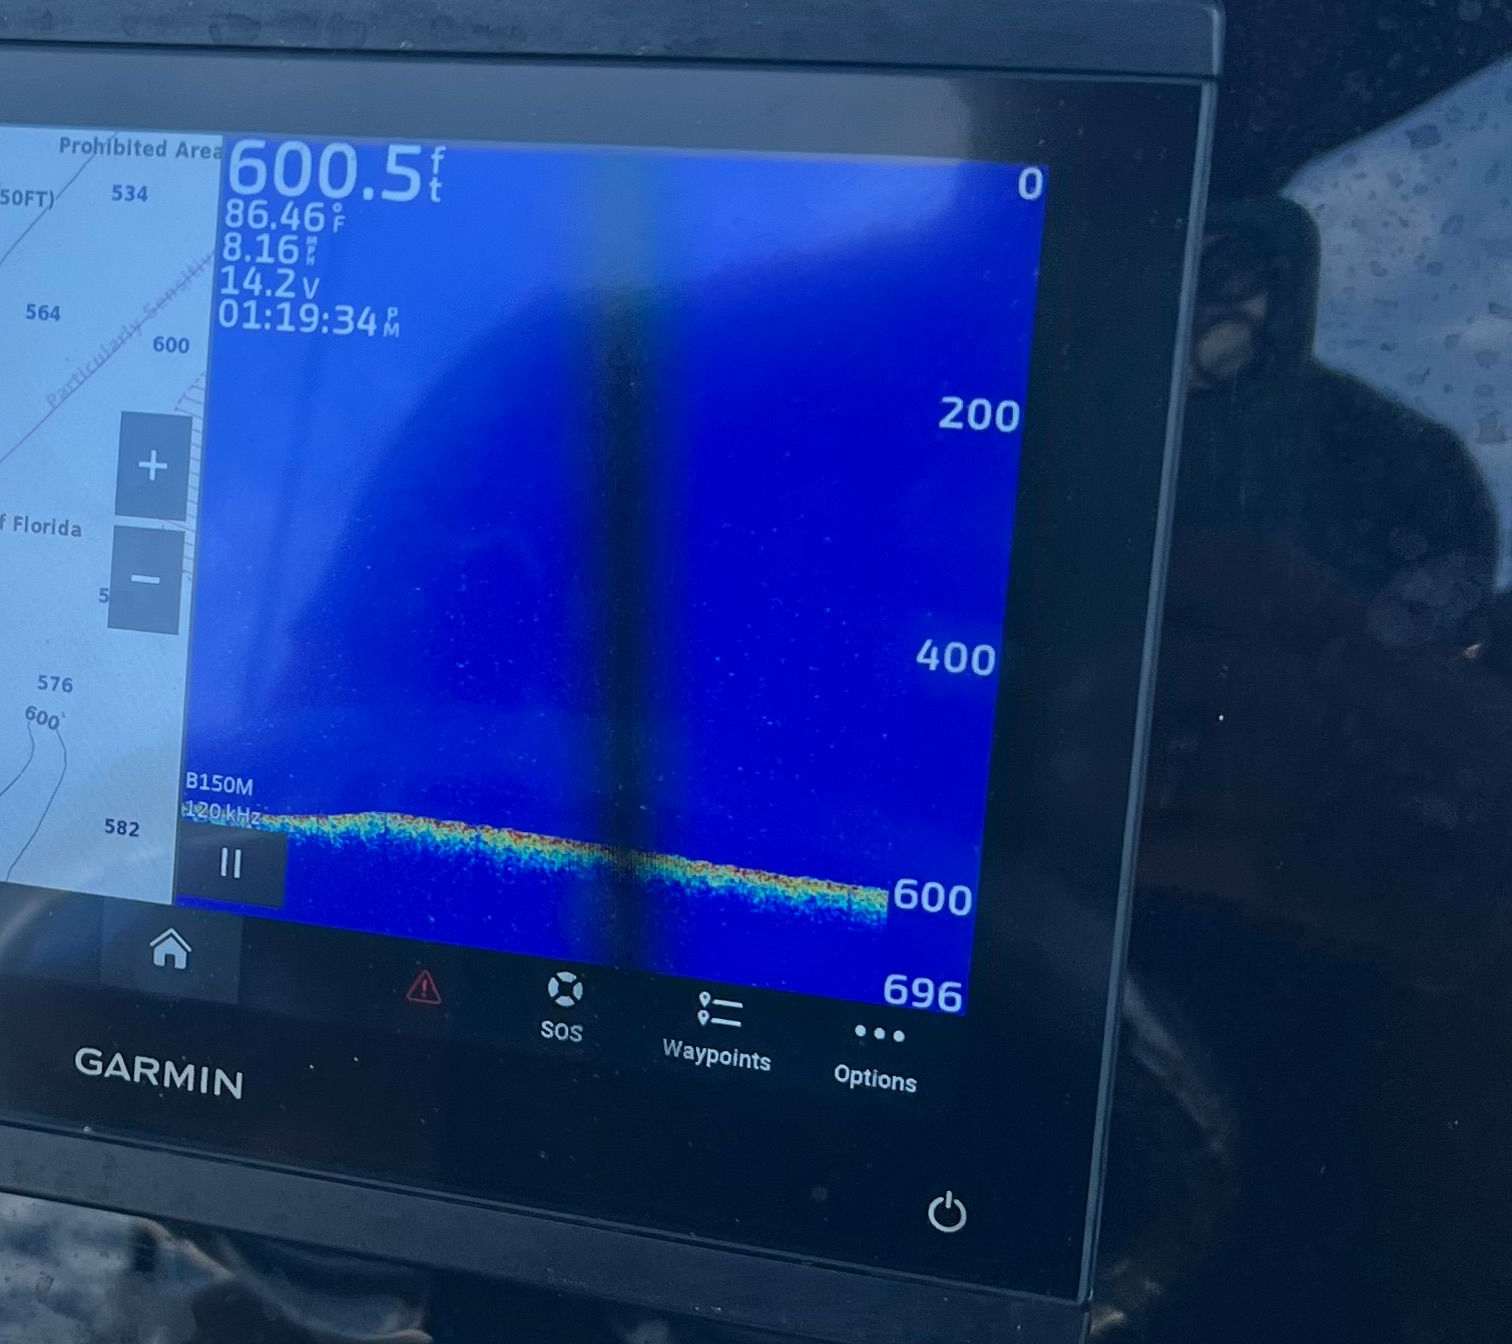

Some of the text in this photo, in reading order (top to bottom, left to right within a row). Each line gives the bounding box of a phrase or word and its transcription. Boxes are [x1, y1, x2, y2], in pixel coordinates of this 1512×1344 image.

[59, 136, 223, 159] Prohibited Area
[229, 139, 422, 201] 600.5
[1018, 166, 1044, 200] 0
[111, 184, 148, 203] 534
[225, 198, 325, 232] 86.46
[223, 231, 299, 264] 8.16
[220, 265, 320, 300] 14.2 V
[25, 303, 61, 322] 564
[218, 298, 377, 337] 01:19:34
[153, 336, 190, 354] 600
[938, 395, 1020, 433] 200
[12, 516, 82, 538] Florida
[915, 638, 996, 677] 400
[37, 674, 74, 694] 576
[24, 705, 60, 731] 600
[186, 771, 254, 796] B150M
[104, 818, 141, 837] 582
[185, 799, 262, 825] 120 kHz
[893, 878, 973, 917] 600
[883, 974, 963, 1014] 696
[540, 1020, 584, 1043] SOS
[662, 1037, 772, 1072] Waypoints
[74, 1047, 244, 1100] GARMIN
[833, 1063, 918, 1094] Options
